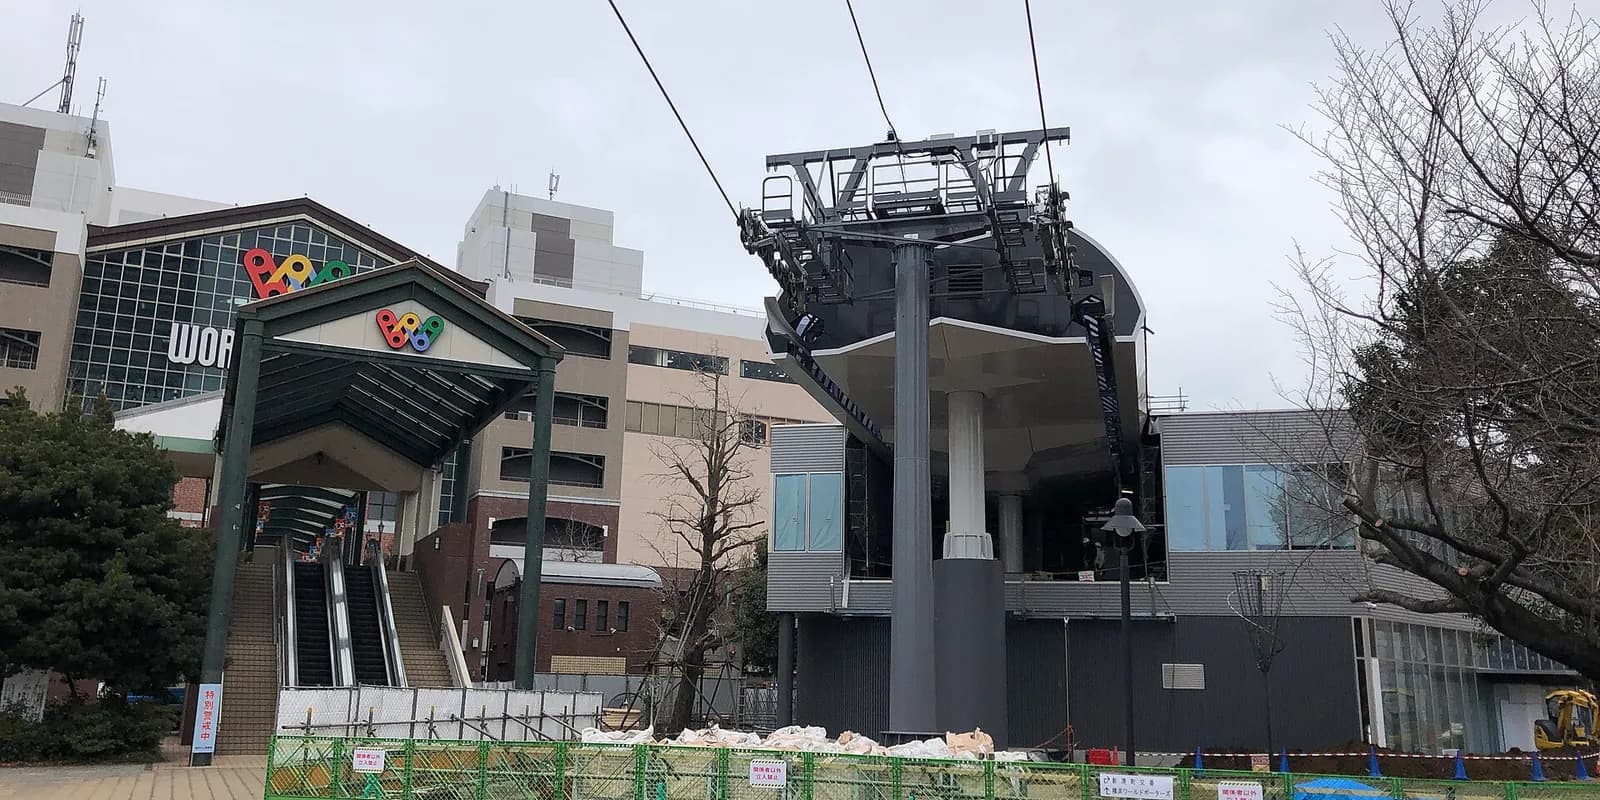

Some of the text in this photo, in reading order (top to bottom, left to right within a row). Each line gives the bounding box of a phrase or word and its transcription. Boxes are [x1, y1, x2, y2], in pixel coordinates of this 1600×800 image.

[200, 690, 215, 740] 特別警戒中
